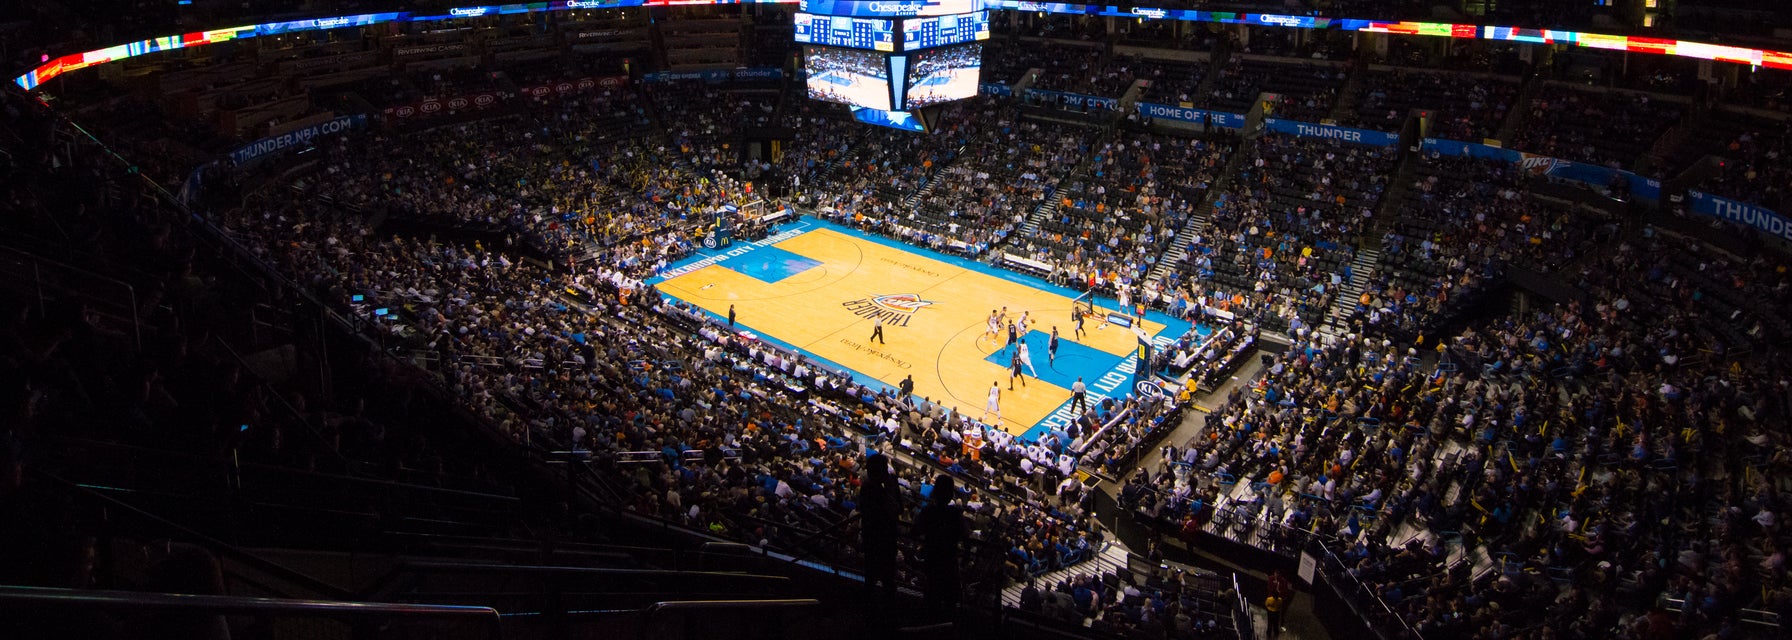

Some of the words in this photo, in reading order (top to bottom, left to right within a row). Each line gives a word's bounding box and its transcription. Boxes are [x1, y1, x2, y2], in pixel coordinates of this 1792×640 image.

[450, 7, 485, 16] Chesapeake
[868, 2, 921, 15] Chesapeake
[1131, 7, 1166, 17] Chesapeake
[1260, 14, 1301, 25] Chesapeake
[397, 46, 437, 56] RIVERWIND
[437, 44, 464, 52] CASINO
[987, 85, 1000, 94] TO
[1150, 106, 1181, 118] HOME
[1184, 110, 1201, 121] OF
[1297, 124, 1361, 142] THUNDER
[1386, 132, 1399, 140] 107
[1523, 157, 1551, 169] OKC
[726, 244, 755, 258] CITY
[1093, 371, 1128, 393] CITY
